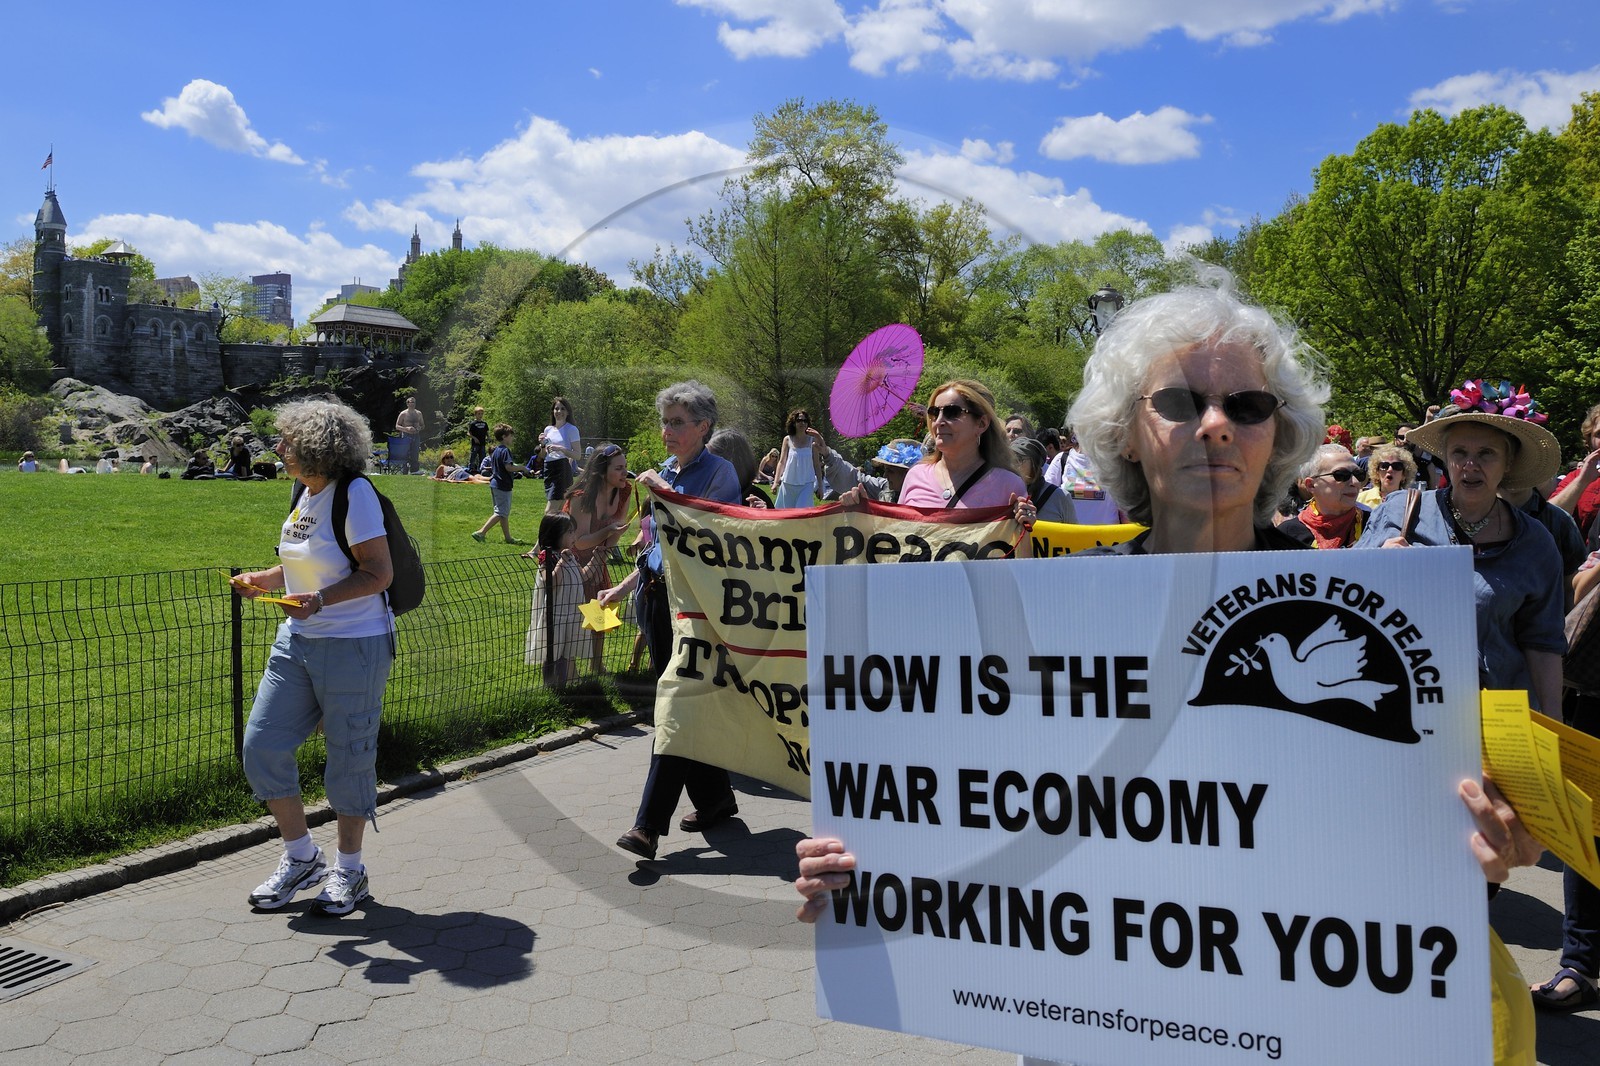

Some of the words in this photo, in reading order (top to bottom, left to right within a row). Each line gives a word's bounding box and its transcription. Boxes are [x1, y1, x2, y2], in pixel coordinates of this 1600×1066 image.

[293, 523, 309, 531] NOT
[720, 578, 806, 630] Bri
[1181, 573, 1317, 656] VETERANS
[1325, 576, 1385, 620] FOR
[1380, 608, 1444, 704] PEACE
[824, 655, 941, 713] HOW
[960, 654, 1011, 716] IS
[1028, 656, 1151, 719] THE
[825, 761, 941, 825] WAR
[958, 768, 1269, 850] ECONOMY
[831, 869, 1090, 956] WORKING
[1113, 898, 1243, 976] FOR
[1262, 911, 1458, 999] YOU?
[952, 988, 1283, 1060] www.veteransforpeace.org
